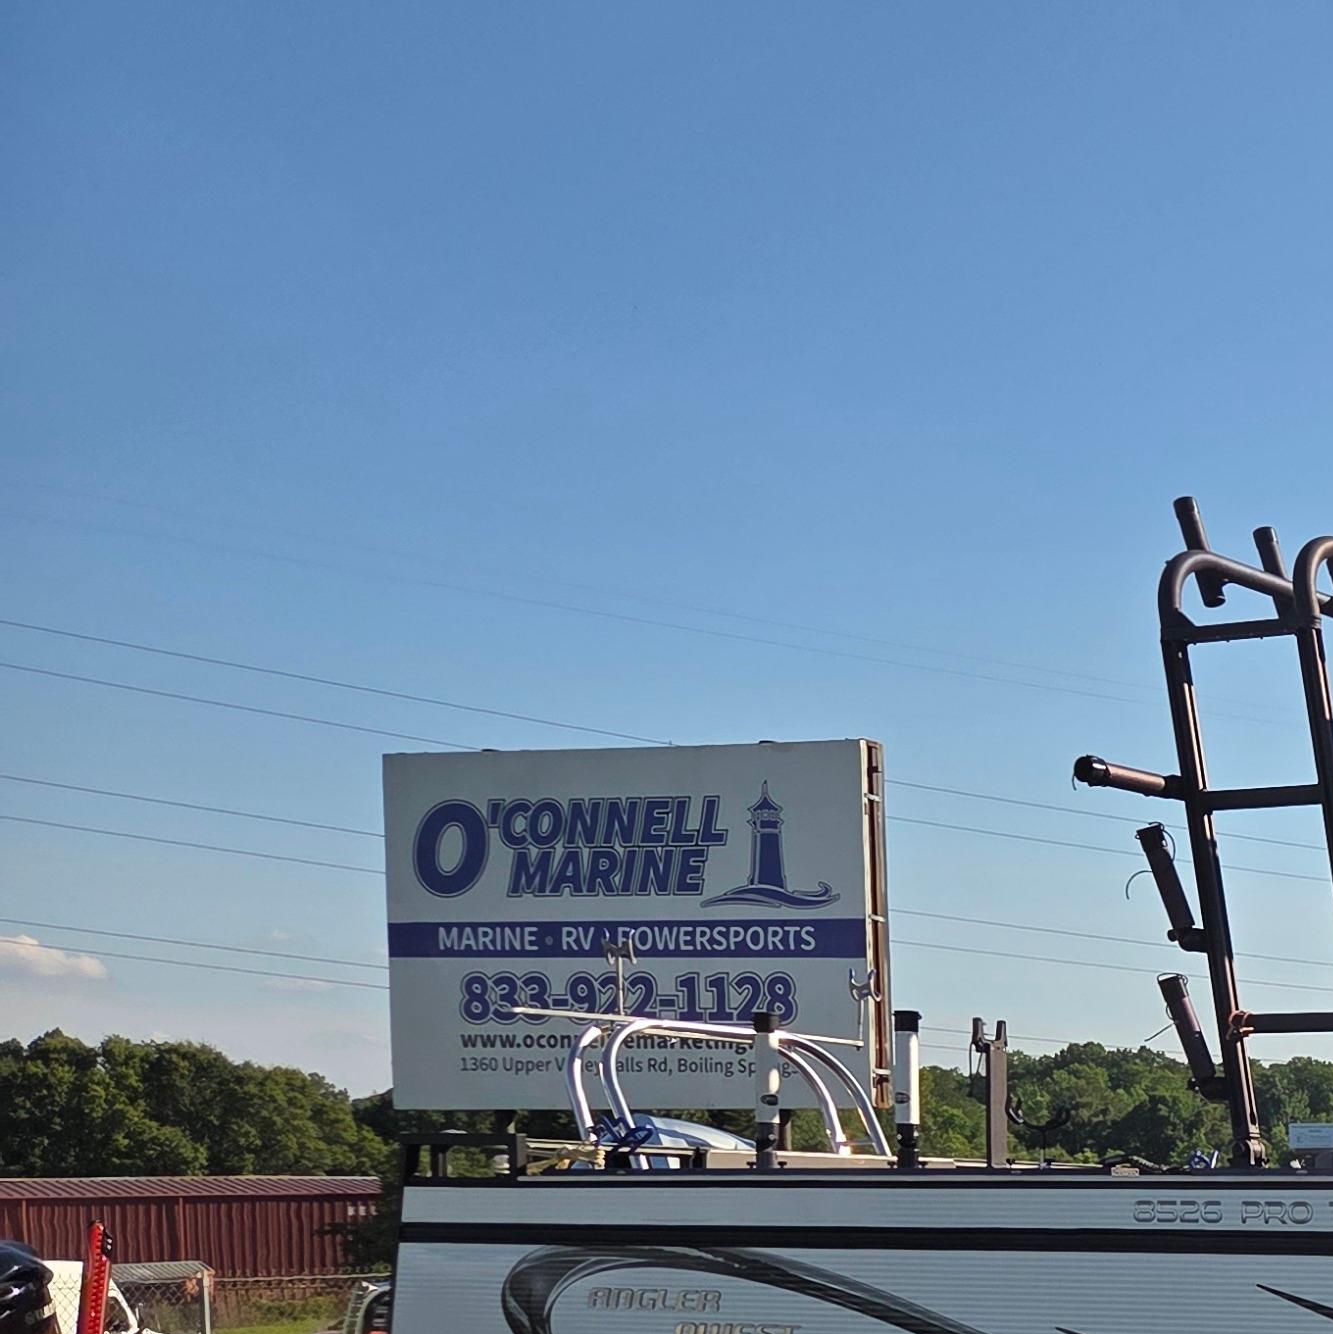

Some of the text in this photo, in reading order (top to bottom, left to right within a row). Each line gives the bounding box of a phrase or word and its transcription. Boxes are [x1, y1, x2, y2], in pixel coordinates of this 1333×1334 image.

[413, 795, 728, 898] O'CONNELL
[507, 845, 709, 897] MARINE
[438, 927, 538, 951] MARINE
[561, 927, 594, 950] RV
[460, 971, 797, 1026] 833-922-1128
[460, 1056, 498, 1072] 1360
[502, 1056, 551, 1076] Upper
[612, 1056, 644, 1073] alls
[648, 1057, 673, 1076] Rd,
[678, 1056, 735, 1077] Boiling
[1133, 1200, 1223, 1224] 8526
[1240, 1200, 1314, 1225] PRO
[587, 1286, 723, 1313] ANGLER
